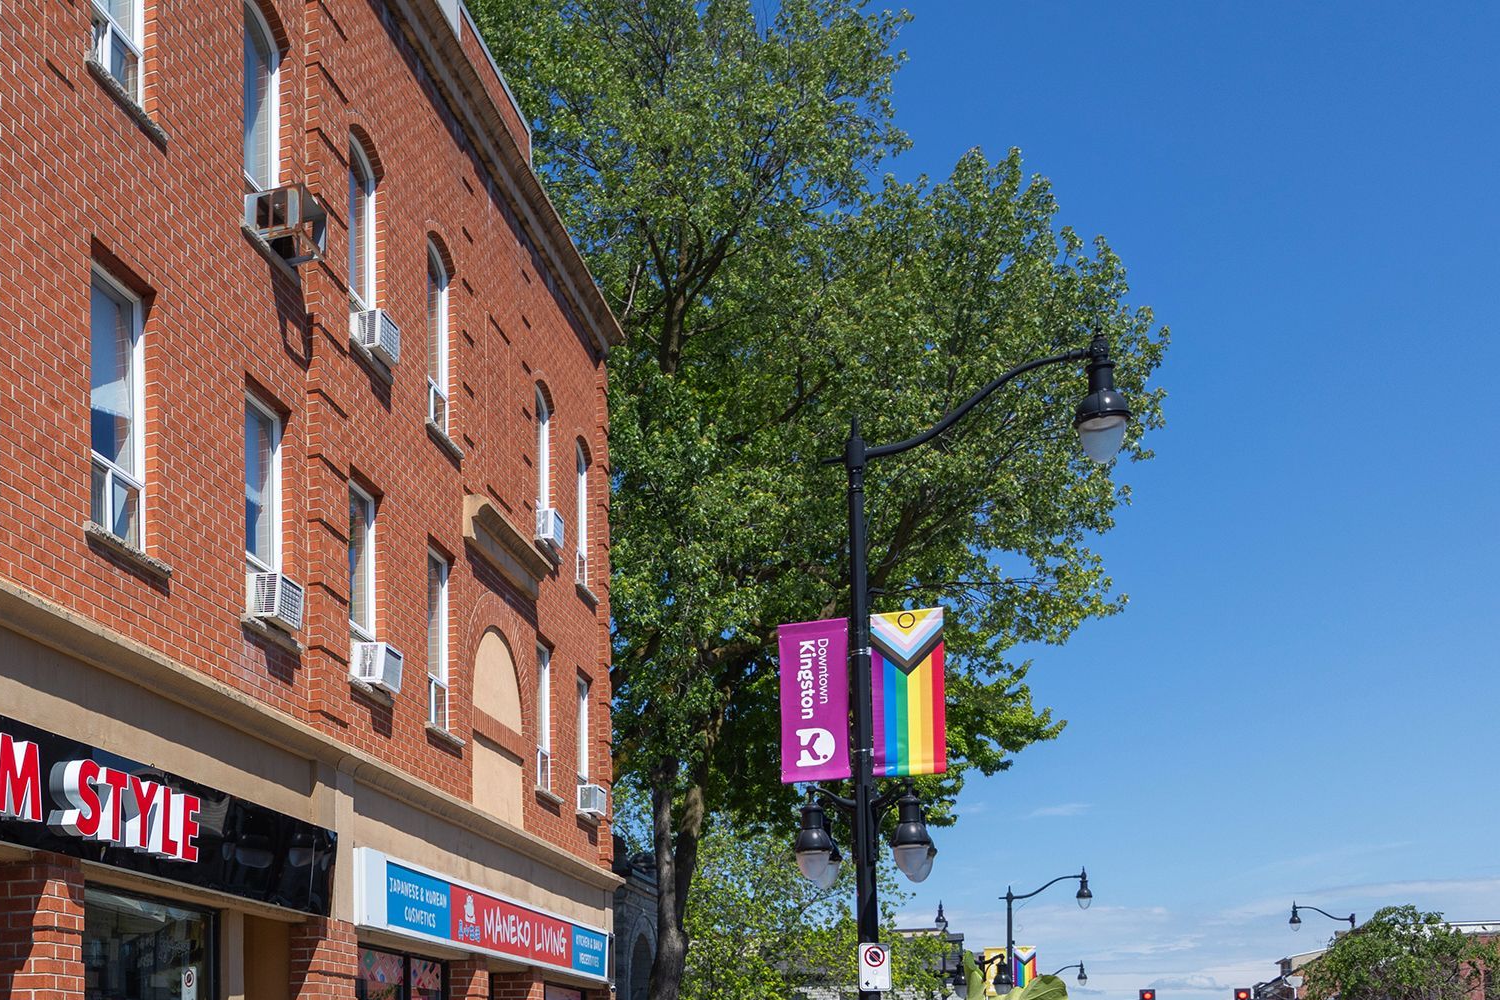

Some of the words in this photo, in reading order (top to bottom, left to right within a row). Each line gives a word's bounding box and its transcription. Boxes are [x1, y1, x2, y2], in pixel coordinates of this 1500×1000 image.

[797, 640, 816, 720] Kingston
[817, 638, 829, 704] Downtown
[53, 758, 200, 863] STYLE
[389, 877, 420, 900] JAPANESE
[420, 887, 424, 902] &
[425, 889, 447, 909] KOREAN
[404, 906, 436, 928] COSMETICS
[483, 906, 530, 948] MANEKO
[534, 922, 567, 959] LIVING
